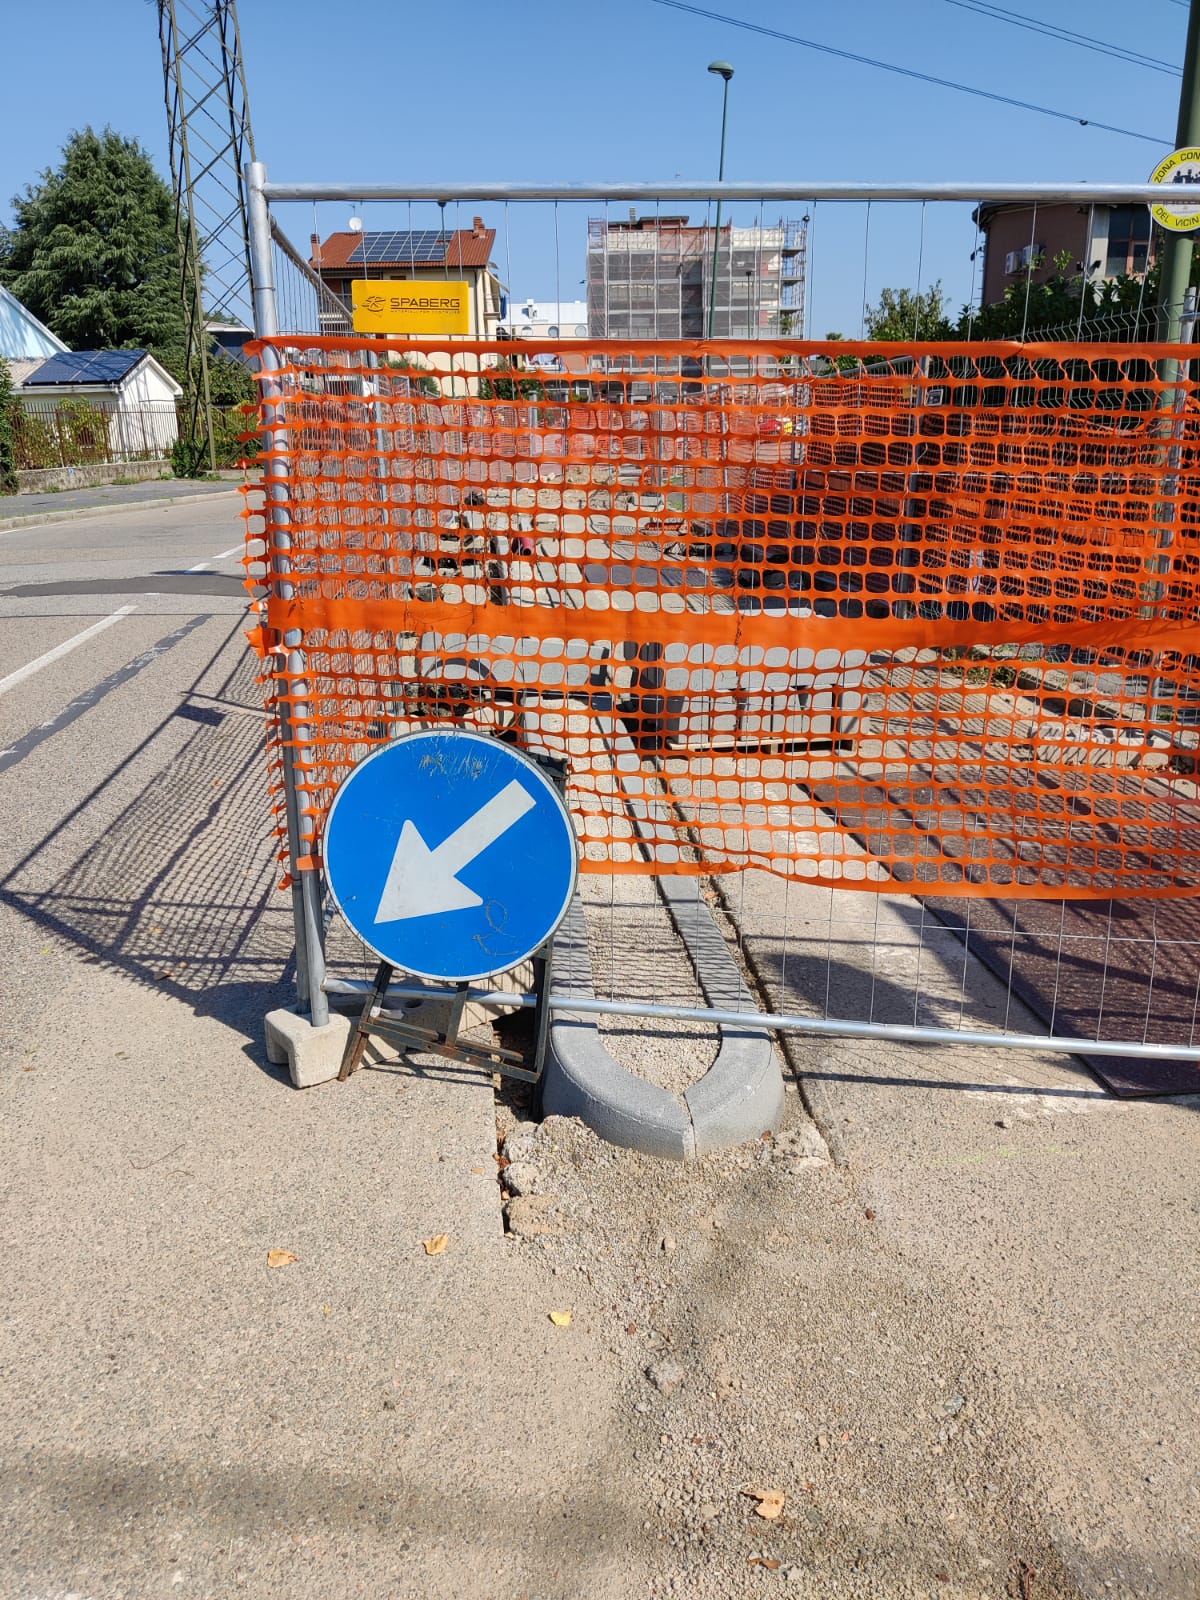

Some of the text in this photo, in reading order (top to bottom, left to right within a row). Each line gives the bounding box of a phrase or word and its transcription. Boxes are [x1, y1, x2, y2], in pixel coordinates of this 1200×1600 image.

[1154, 159, 1176, 184] ZONA
[1155, 207, 1170, 223] DEL
[390, 297, 460, 308] SPABERG
